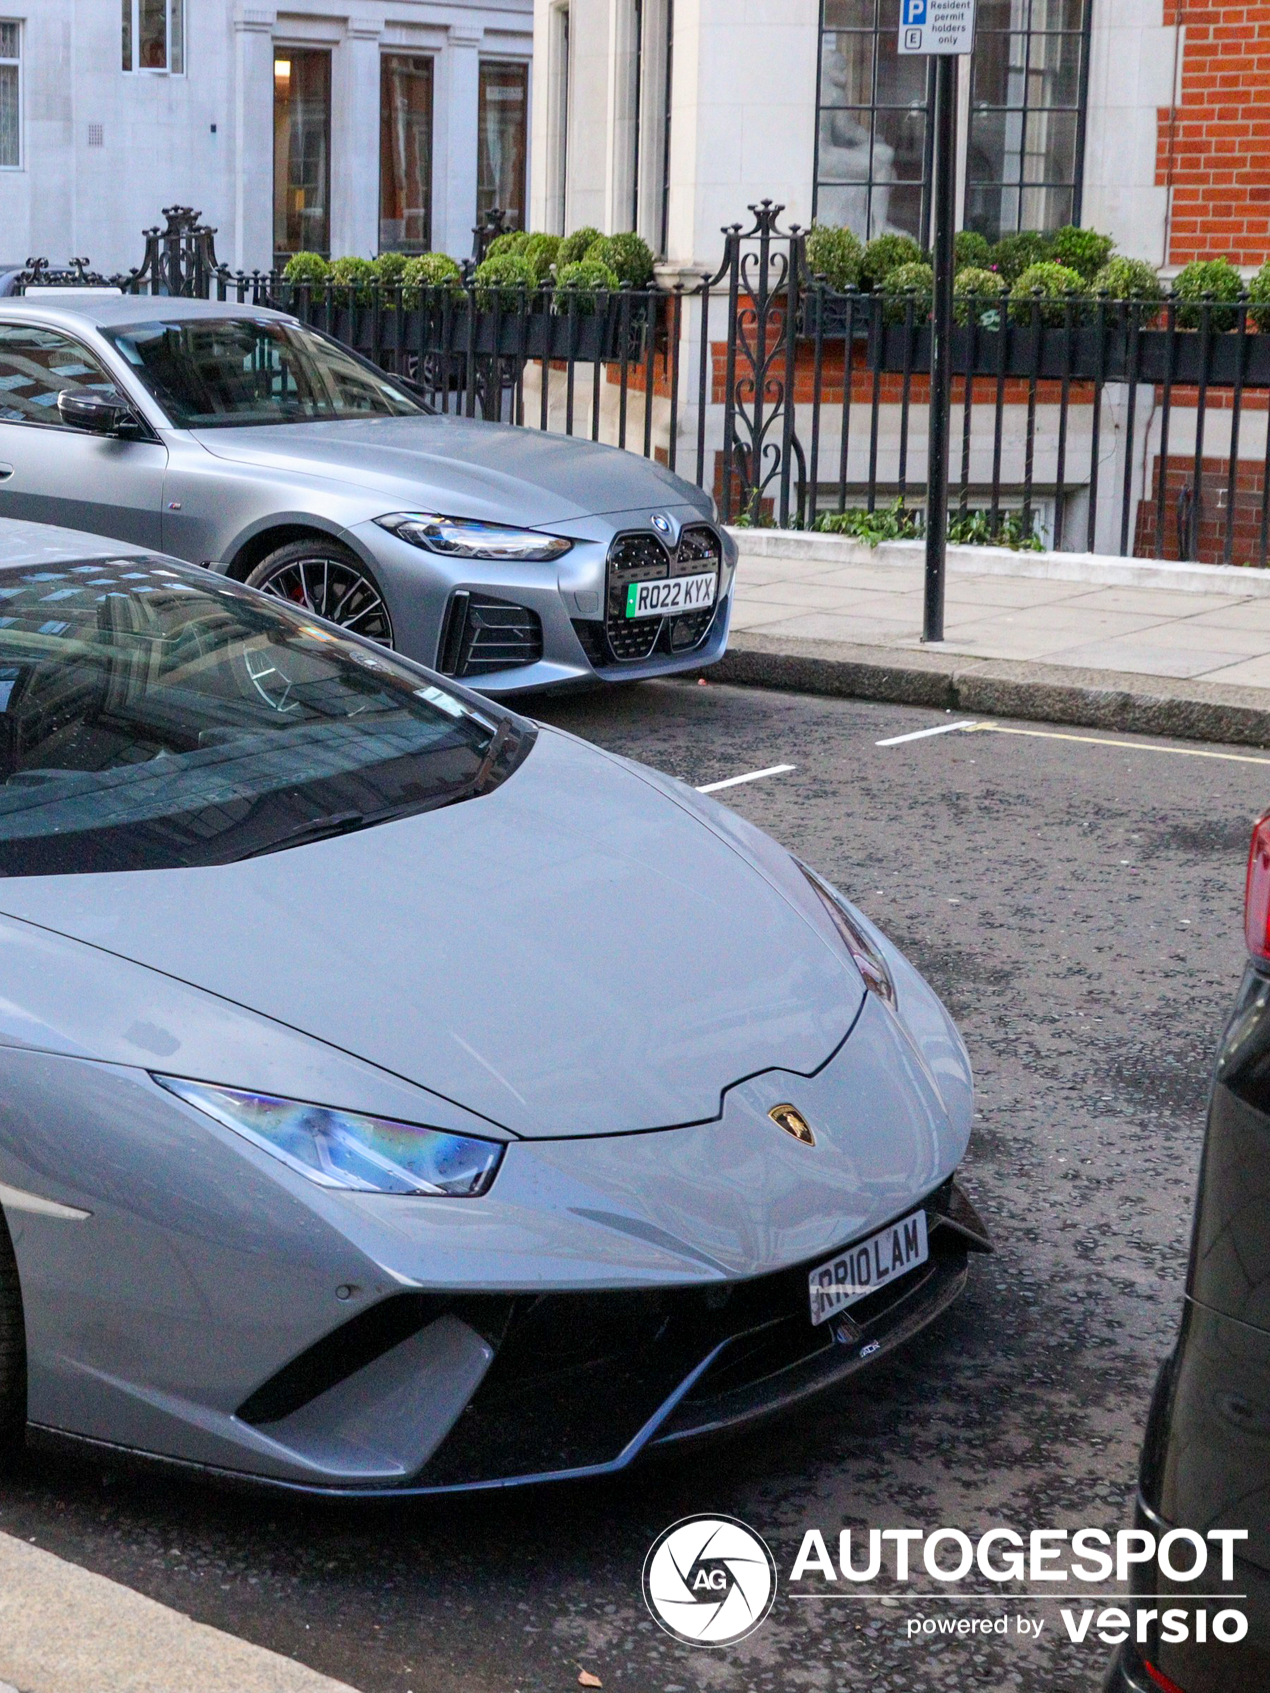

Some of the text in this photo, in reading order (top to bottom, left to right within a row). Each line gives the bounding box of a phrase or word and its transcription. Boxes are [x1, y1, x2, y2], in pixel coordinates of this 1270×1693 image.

[930, 0, 971, 10] Resident
[908, 0, 925, 23] P
[934, 12, 964, 22] permit
[932, 24, 966, 32] holders
[910, 33, 917, 43] E
[938, 35, 958, 45] only
[638, 577, 712, 611] RO22 KYX
[874, 1219, 919, 1280] LAM
